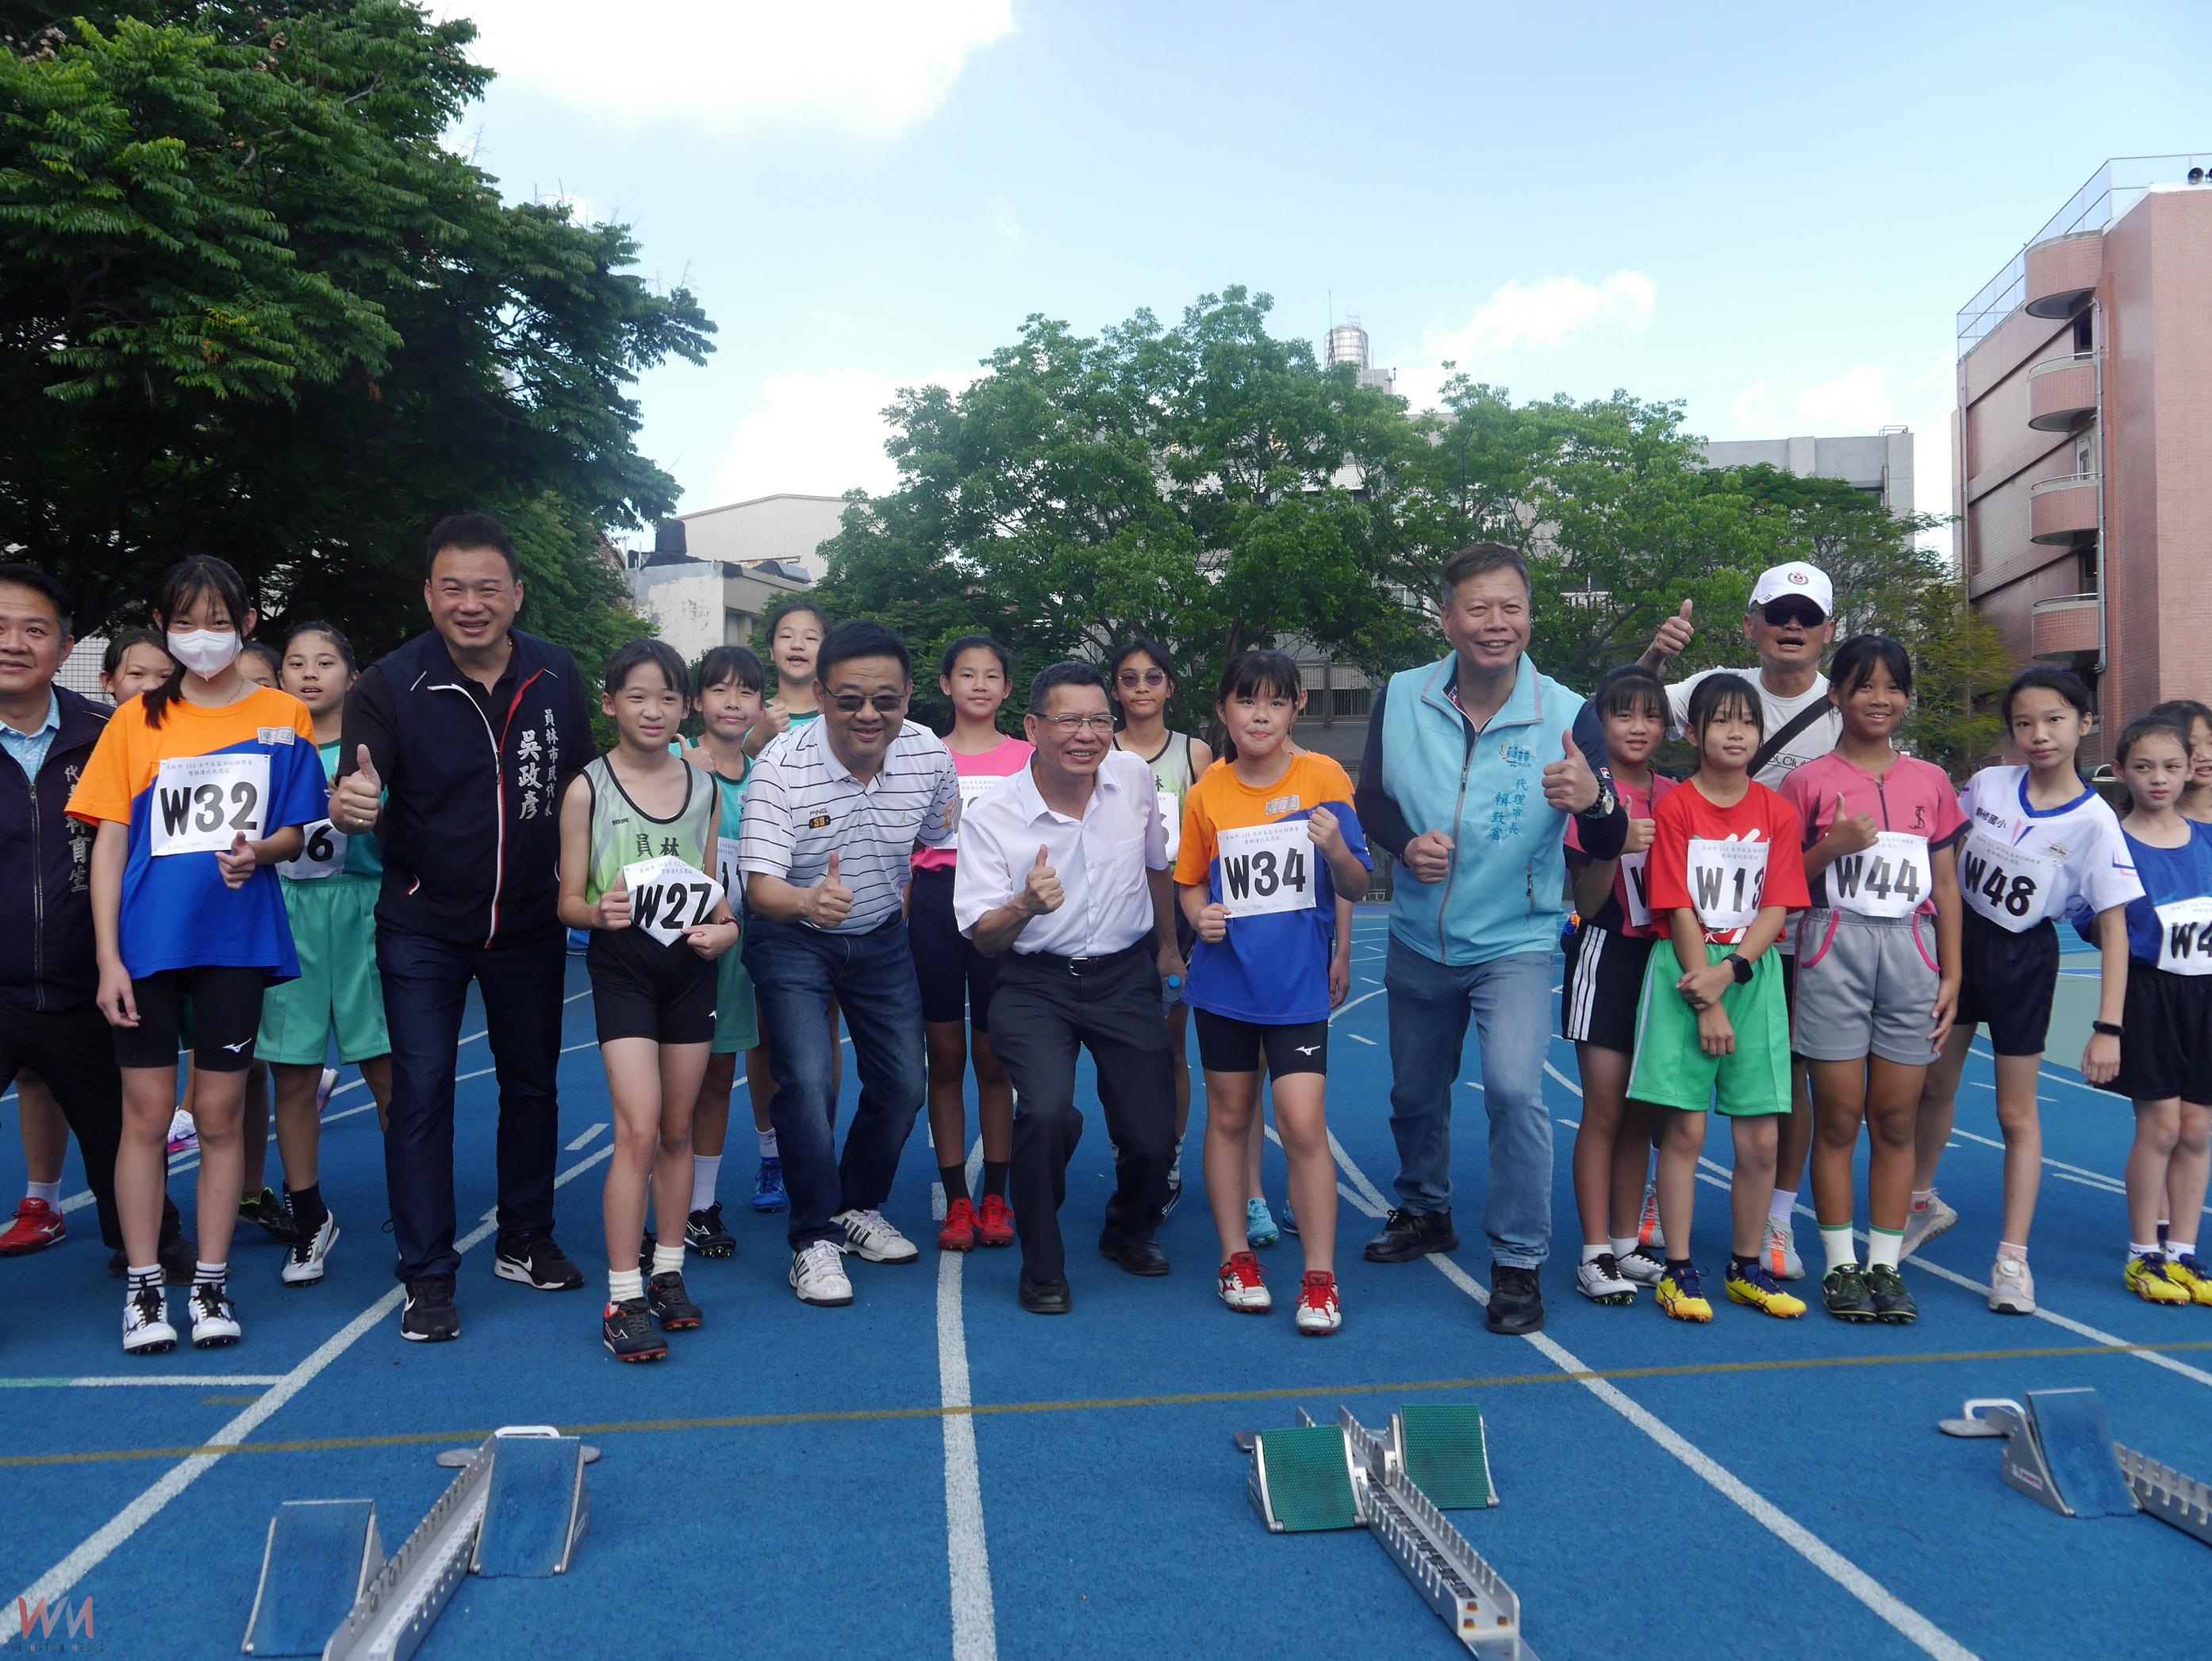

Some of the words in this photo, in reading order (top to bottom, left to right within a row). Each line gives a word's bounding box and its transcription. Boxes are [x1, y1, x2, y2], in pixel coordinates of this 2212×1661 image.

[159, 782, 257, 837] W32
[809, 808, 828, 817] PING
[636, 833, 680, 857] 員林
[1224, 847, 1306, 900] W34
[1695, 866, 1765, 913] W13
[1835, 855, 1919, 902] W44
[1964, 850, 2037, 917] W48
[635, 882, 712, 929] W27
